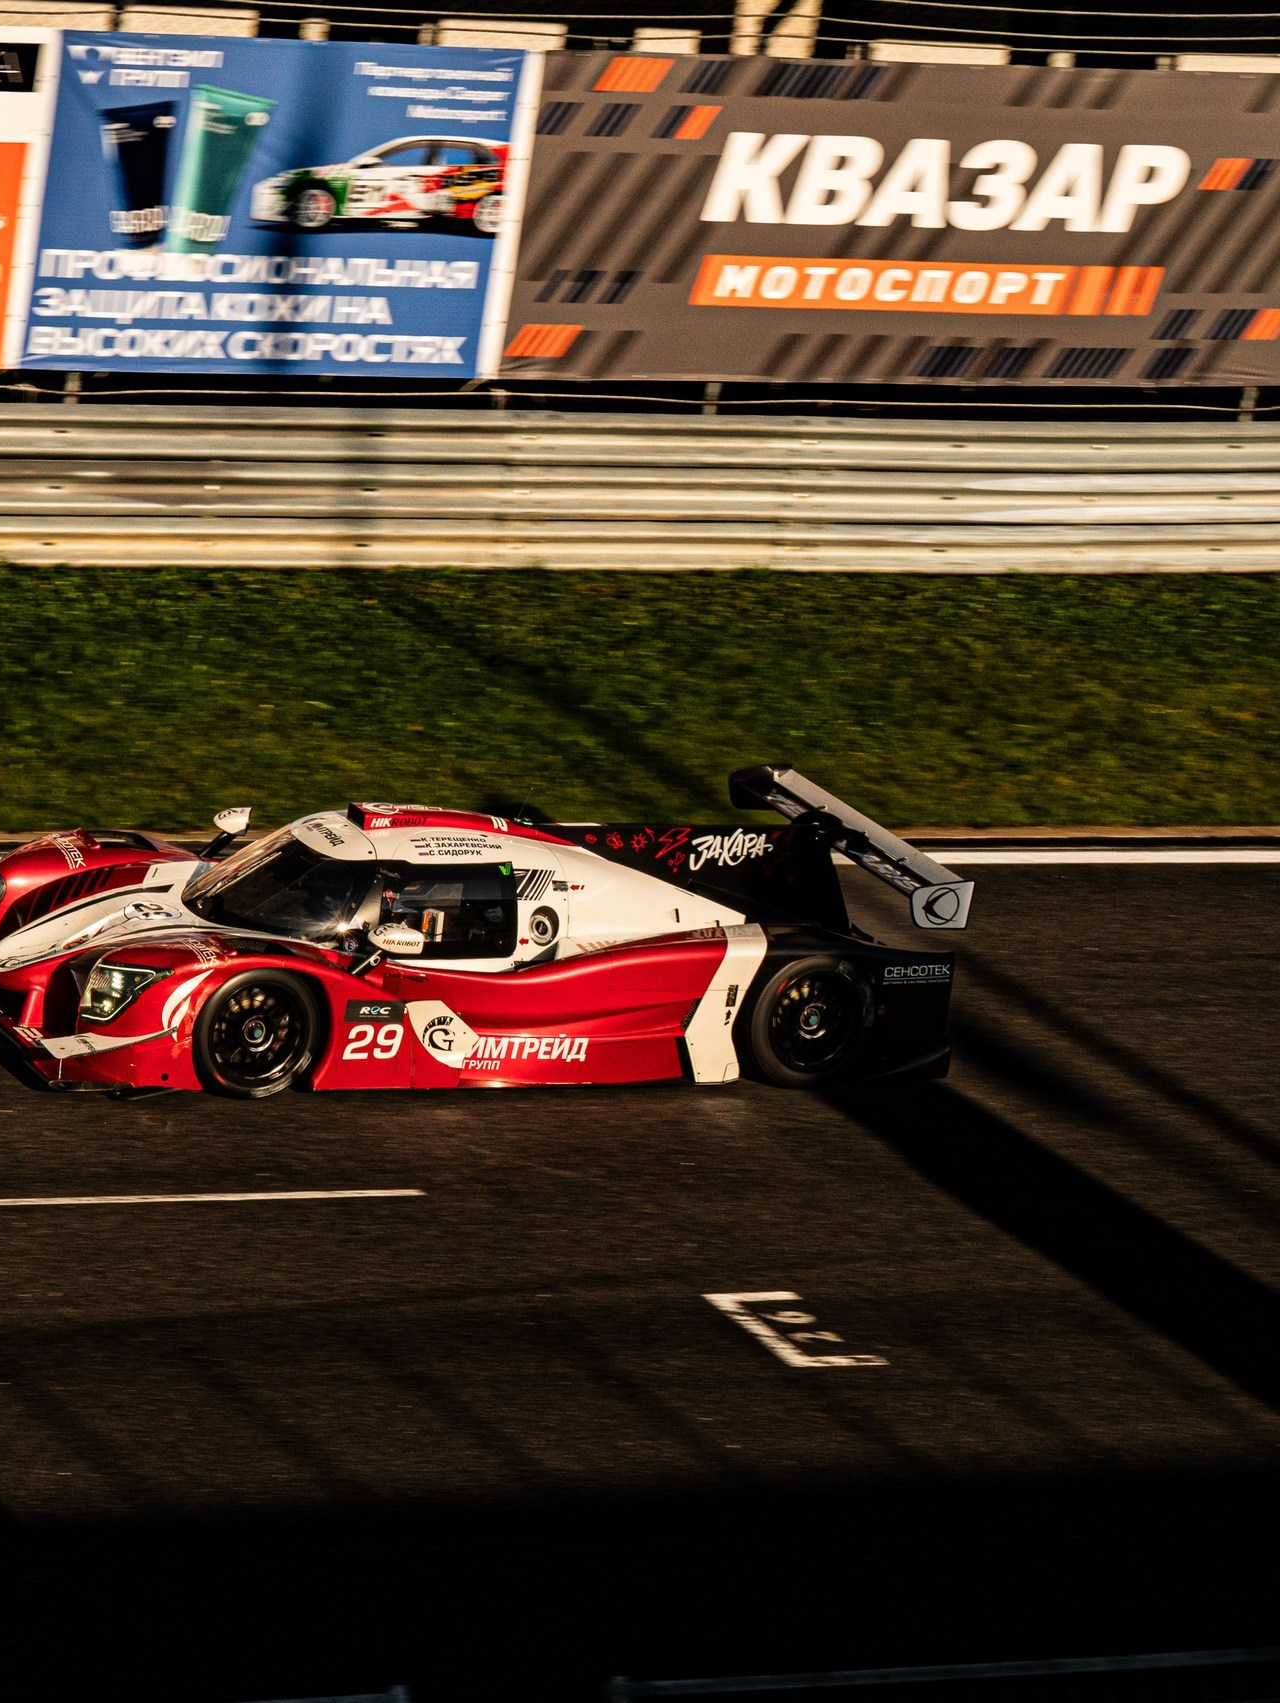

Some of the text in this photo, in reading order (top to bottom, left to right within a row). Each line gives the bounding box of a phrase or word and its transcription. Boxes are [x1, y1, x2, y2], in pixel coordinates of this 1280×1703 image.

[700, 131, 1191, 233] КВАЗАР
[713, 266, 1068, 305] МОТОСПОРТ
[342, 1024, 404, 1060] 29
[462, 1060, 501, 1070] ГРУПП
